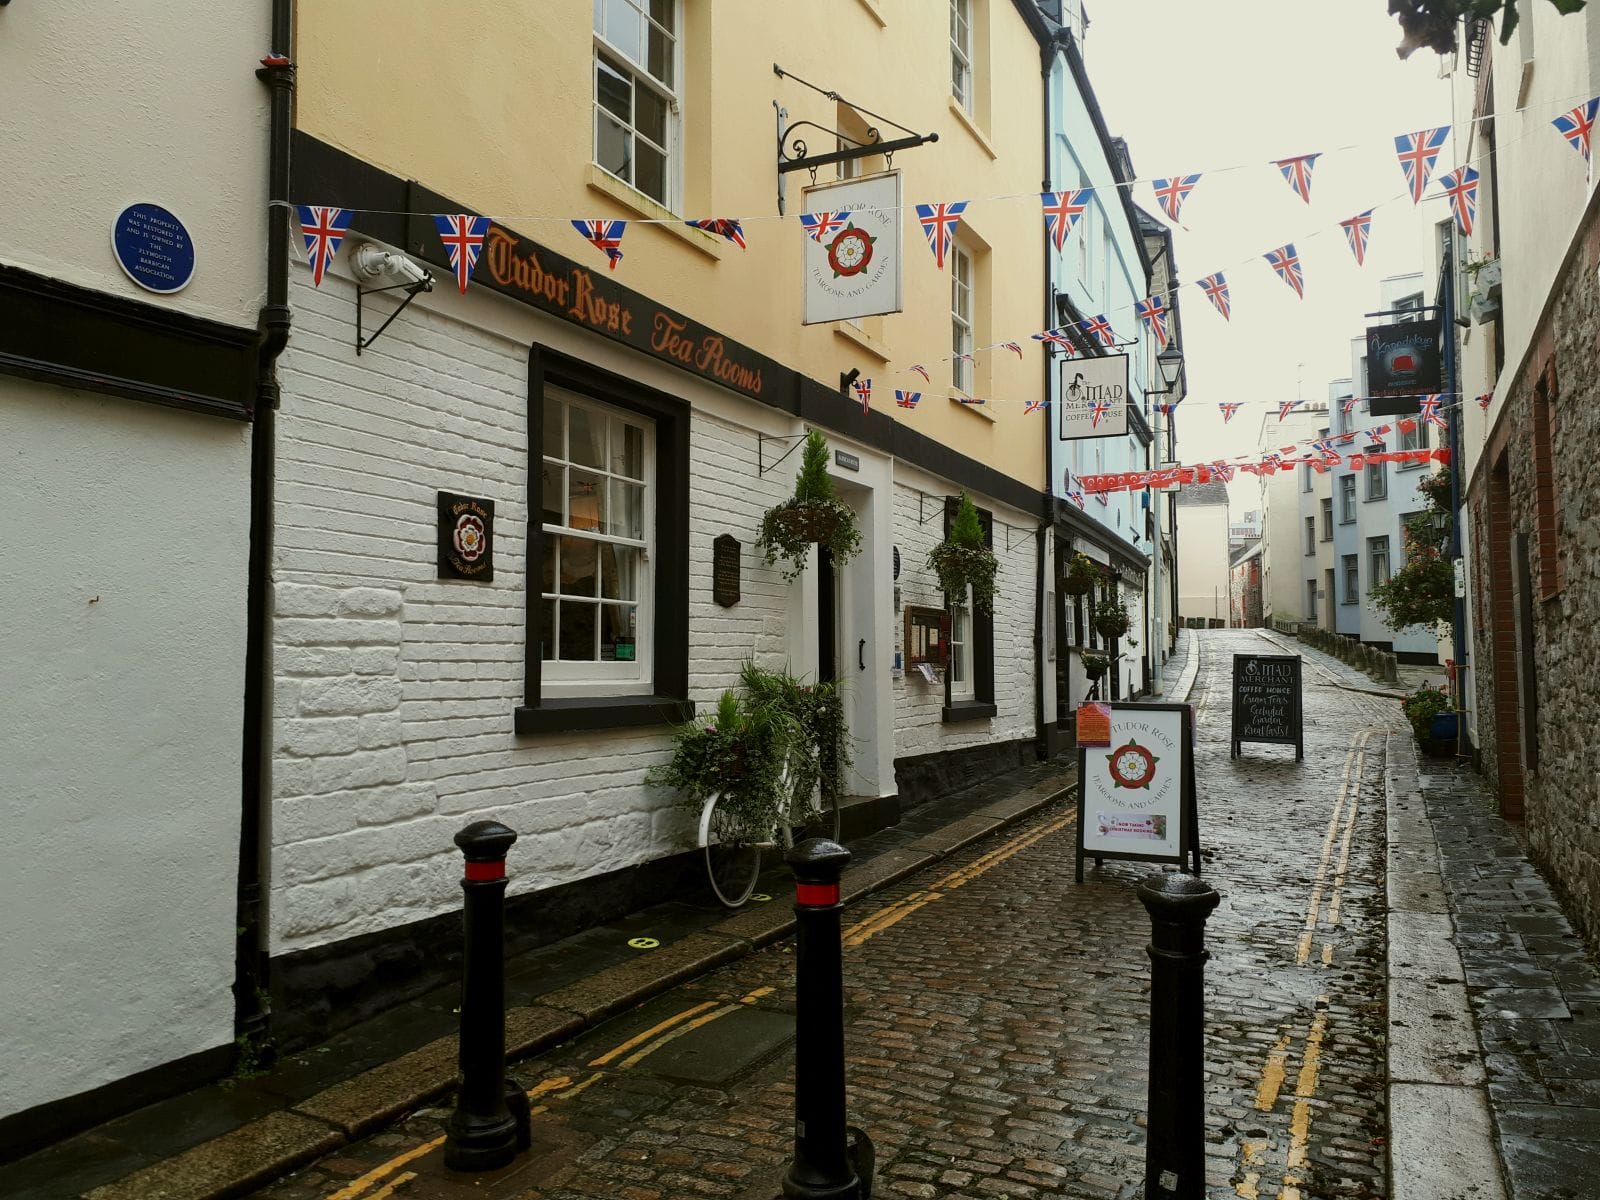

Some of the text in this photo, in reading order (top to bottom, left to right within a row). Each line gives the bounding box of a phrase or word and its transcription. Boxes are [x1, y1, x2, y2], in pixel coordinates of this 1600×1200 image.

[128, 219, 140, 227] WAS
[143, 224, 174, 238] RESTORED
[133, 211, 180, 231] THIS PROPERTY
[126, 227, 140, 235] AND
[151, 235, 174, 246] OWNED
[138, 248, 172, 263] PLYMOUTH
[149, 242, 162, 251] THE
[134, 265, 175, 281] ASSOCIATION
[140, 257, 170, 271] BARBICAN
[812, 256, 889, 298] TEAROOMS AND GARDEN
[487, 226, 763, 395] Tudor Rose Tea Rooms
[1086, 384, 1123, 401] MAD
[1241, 675, 1296, 684] MERCHANT
[1262, 664, 1292, 677] MAD
[1111, 721, 1149, 733] TUDOR
[1151, 727, 1175, 751] ROSE
[1092, 775, 1173, 809] TEAROOMS AND GARDEN
